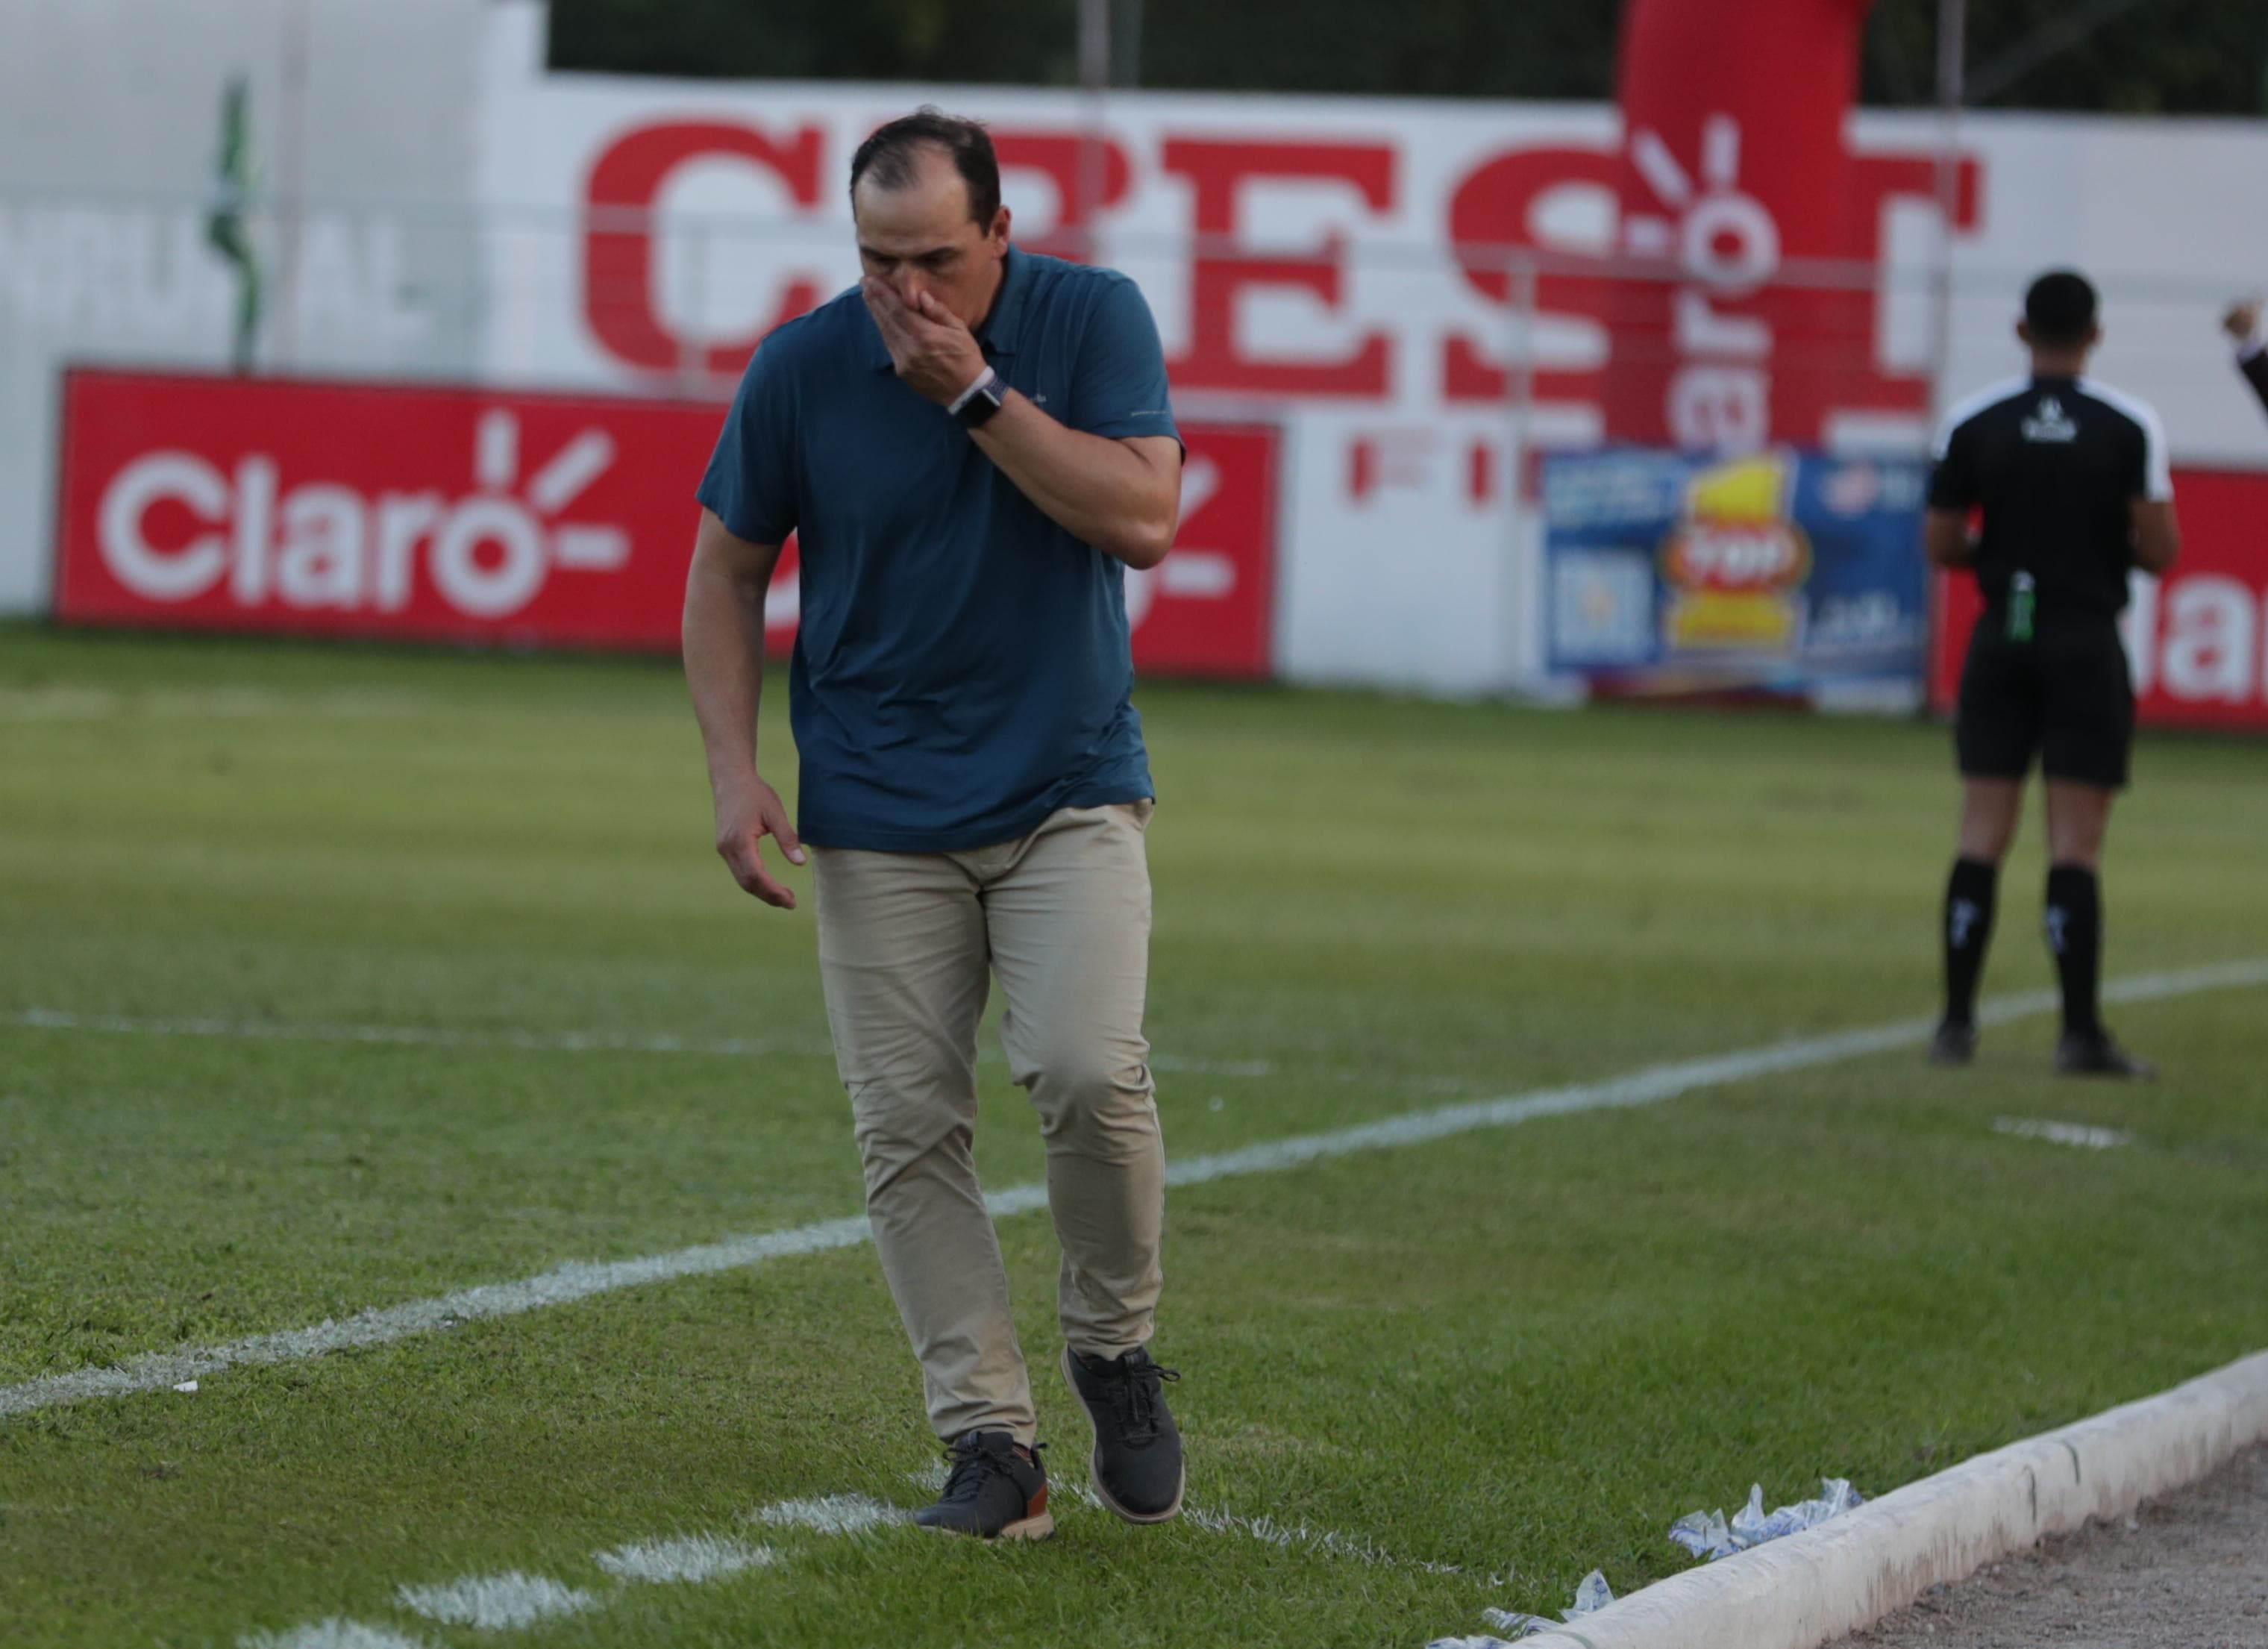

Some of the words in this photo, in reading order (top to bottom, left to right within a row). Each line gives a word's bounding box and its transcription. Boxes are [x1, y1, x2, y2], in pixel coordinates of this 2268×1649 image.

[583, 116, 1982, 416] CEST
[1670, 190, 1782, 457] aro
[97, 449, 551, 618] Claro
